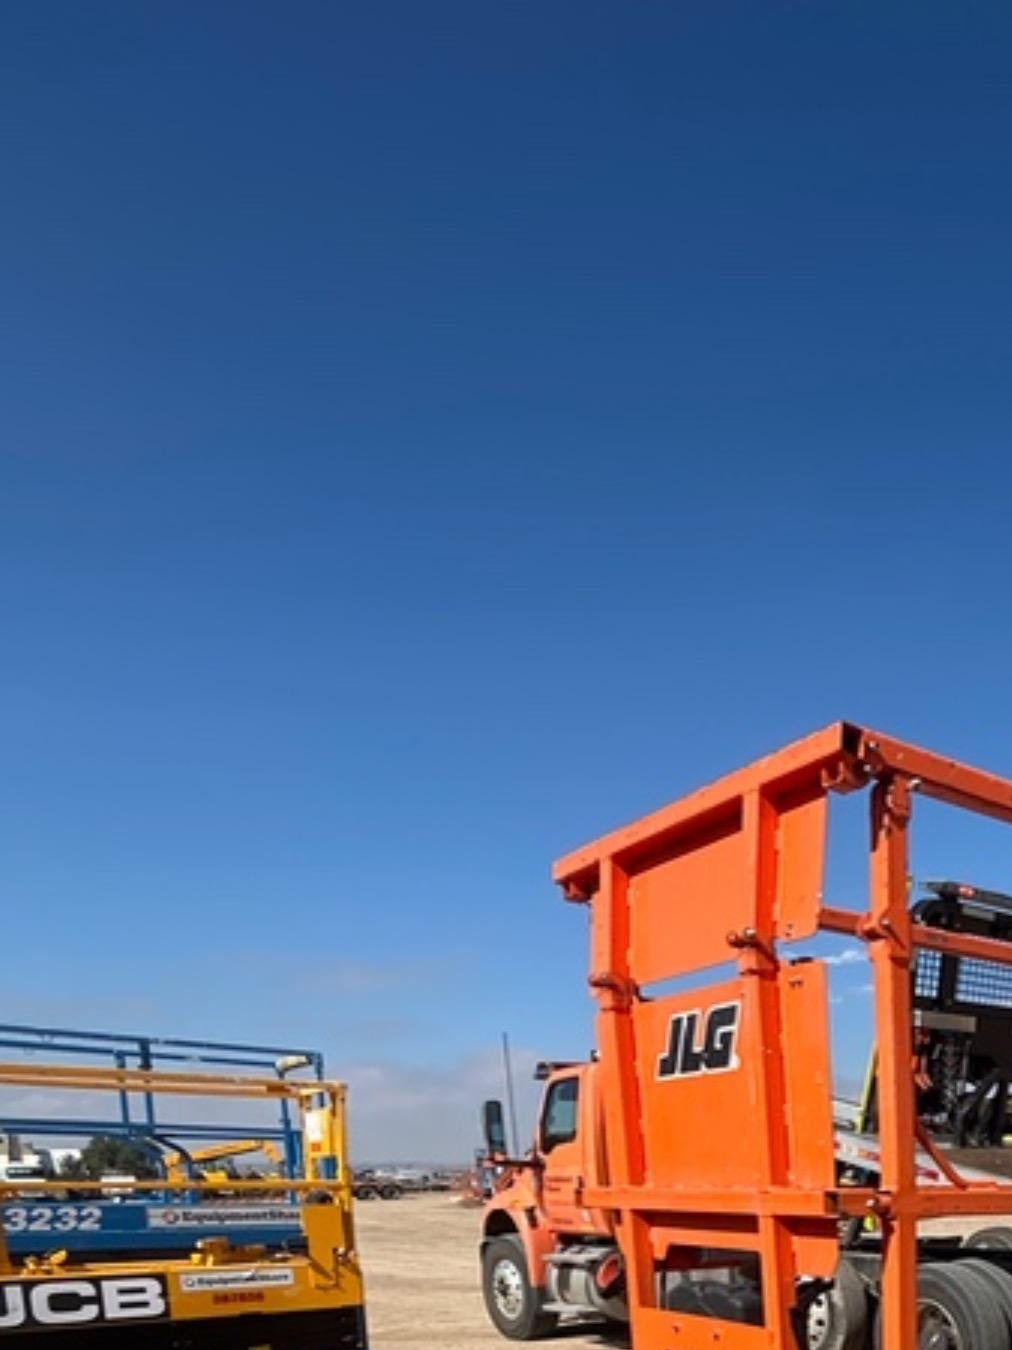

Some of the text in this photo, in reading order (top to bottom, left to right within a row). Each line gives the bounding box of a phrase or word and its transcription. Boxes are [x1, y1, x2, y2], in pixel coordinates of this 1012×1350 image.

[658, 1003, 739, 1079] JLG
[3, 1208, 103, 1231] 3232
[0, 1278, 166, 1327] JCB
